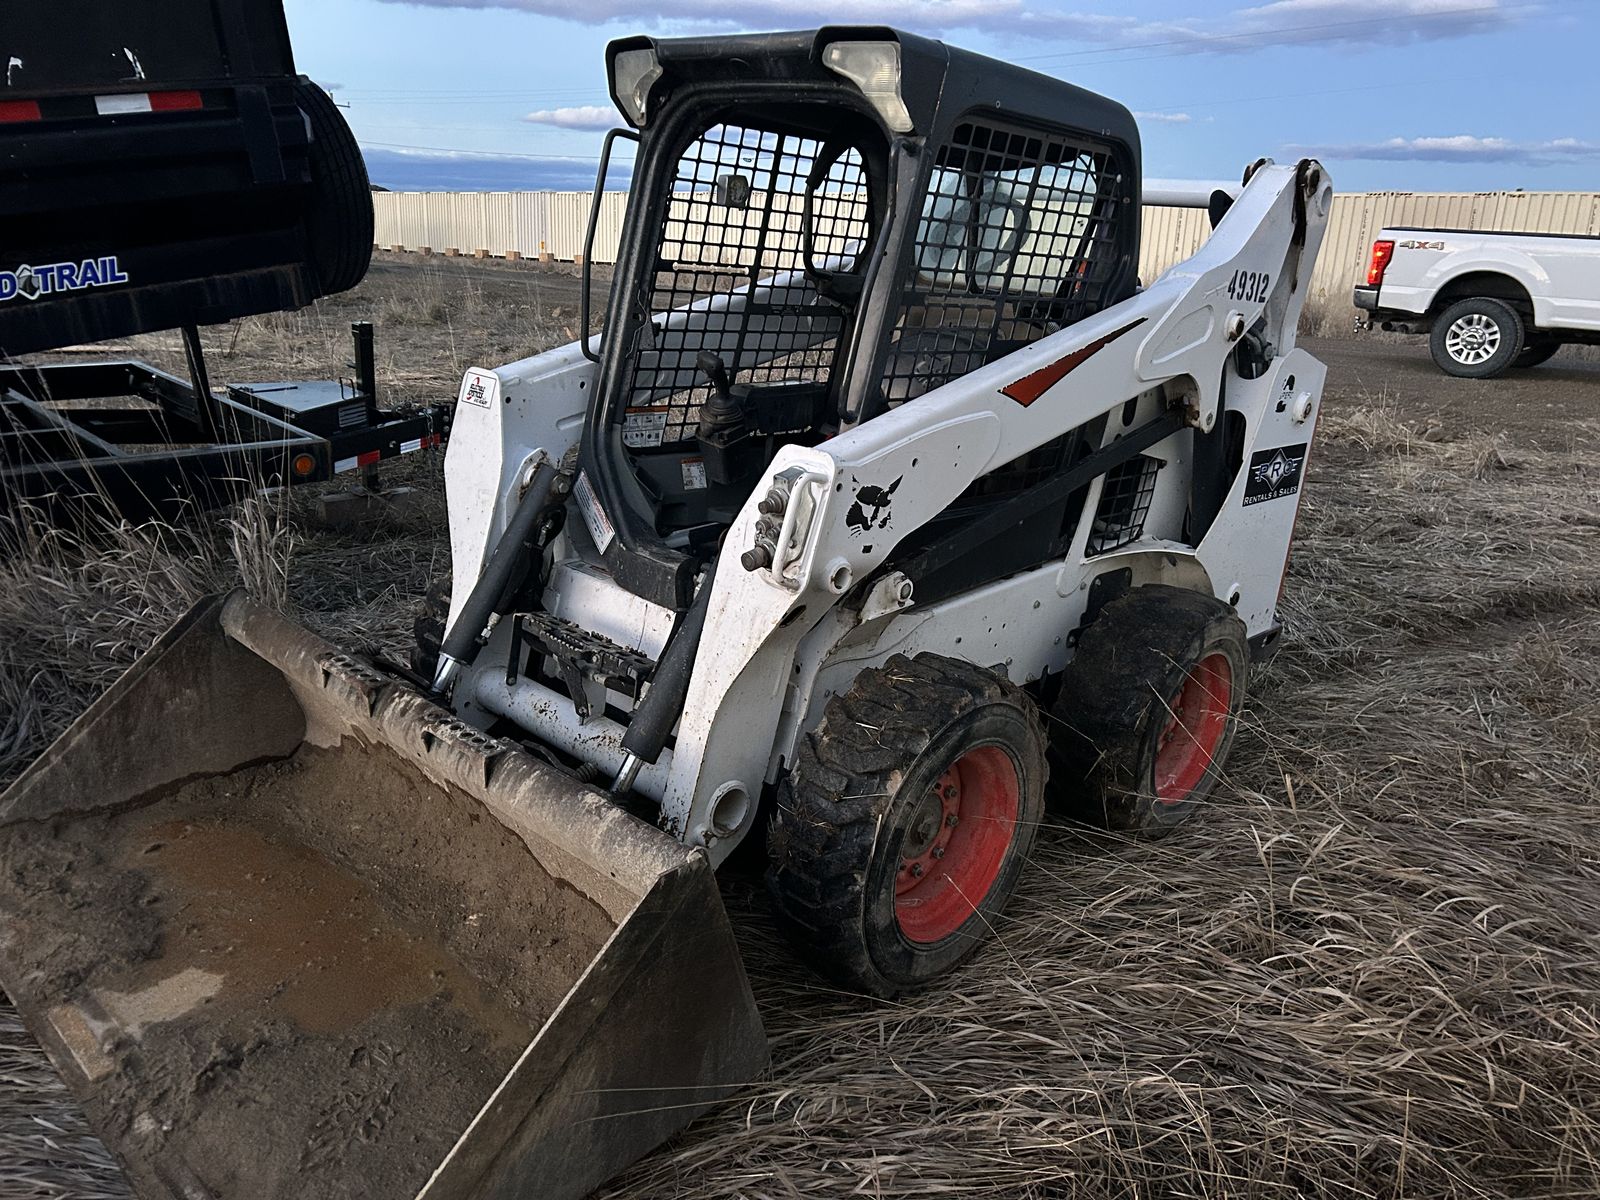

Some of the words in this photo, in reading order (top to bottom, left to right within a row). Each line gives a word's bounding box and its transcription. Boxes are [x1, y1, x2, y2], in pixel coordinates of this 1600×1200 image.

[32, 256, 128, 294] TRAIL
[1227, 269, 1270, 303] 49312
[1257, 458, 1294, 482] PRO
[1244, 493, 1272, 505] RENTALS
[1272, 490, 1278, 498] &
[1279, 486, 1297, 496] SALES
